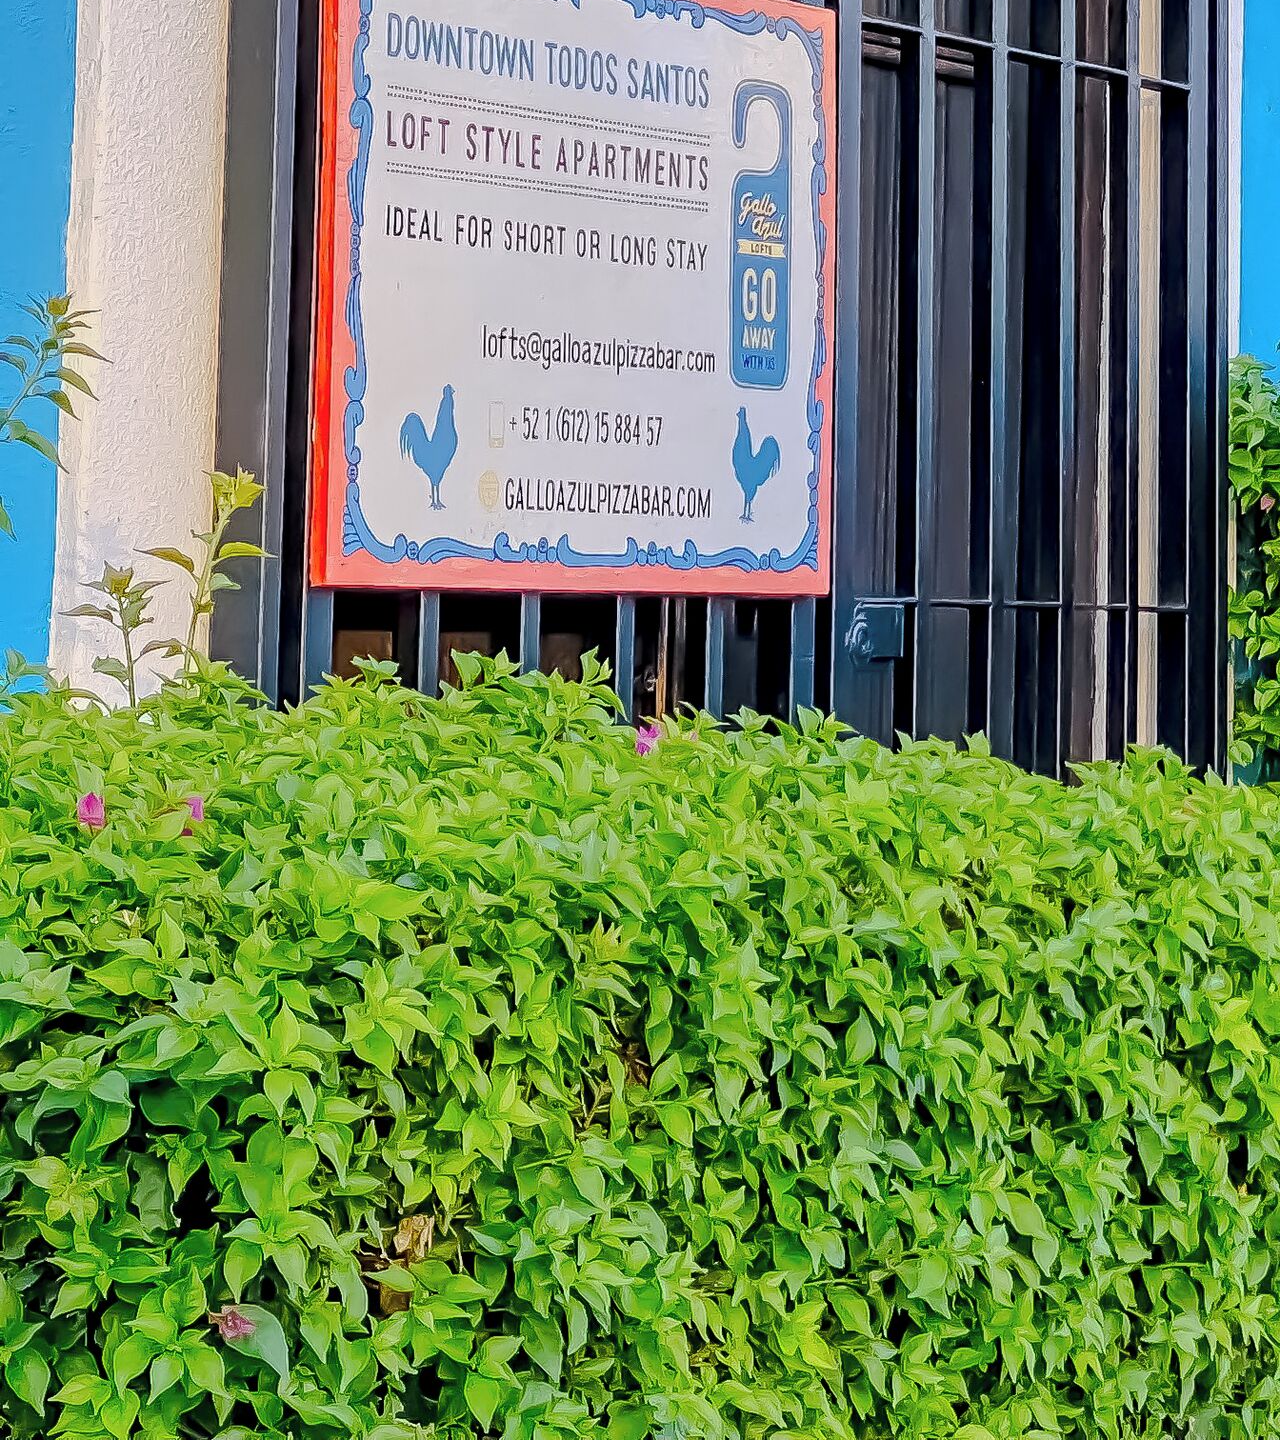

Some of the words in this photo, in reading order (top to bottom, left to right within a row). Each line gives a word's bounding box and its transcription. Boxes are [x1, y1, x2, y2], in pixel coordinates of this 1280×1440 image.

[387, 12, 534, 81] DOWNTOWN
[545, 41, 617, 95] TODOS
[627, 58, 710, 108] SANTOS
[386, 111, 450, 154] LOFT
[466, 123, 541, 169] STYLE
[556, 137, 709, 191] APARTMENTS
[386, 204, 442, 242] IDEAL
[456, 214, 492, 248] FOR
[504, 220, 566, 255] SHORT
[576, 229, 600, 259] OR
[610, 234, 656, 266] LONG
[667, 238, 708, 271] STAY
[742, 267, 777, 323] GO
[482, 324, 716, 375] lofts@galloazulpizzabar.com
[742, 325, 776, 351] AWAY
[523, 407, 538, 440] 52
[545, 409, 551, 440] 1
[556, 405, 590, 444] (612)
[594, 411, 609, 444] 15
[614, 413, 640, 445] 884
[646, 416, 663, 446] 57
[505, 477, 712, 518] GALLOAZULPIZZABAR.COM
